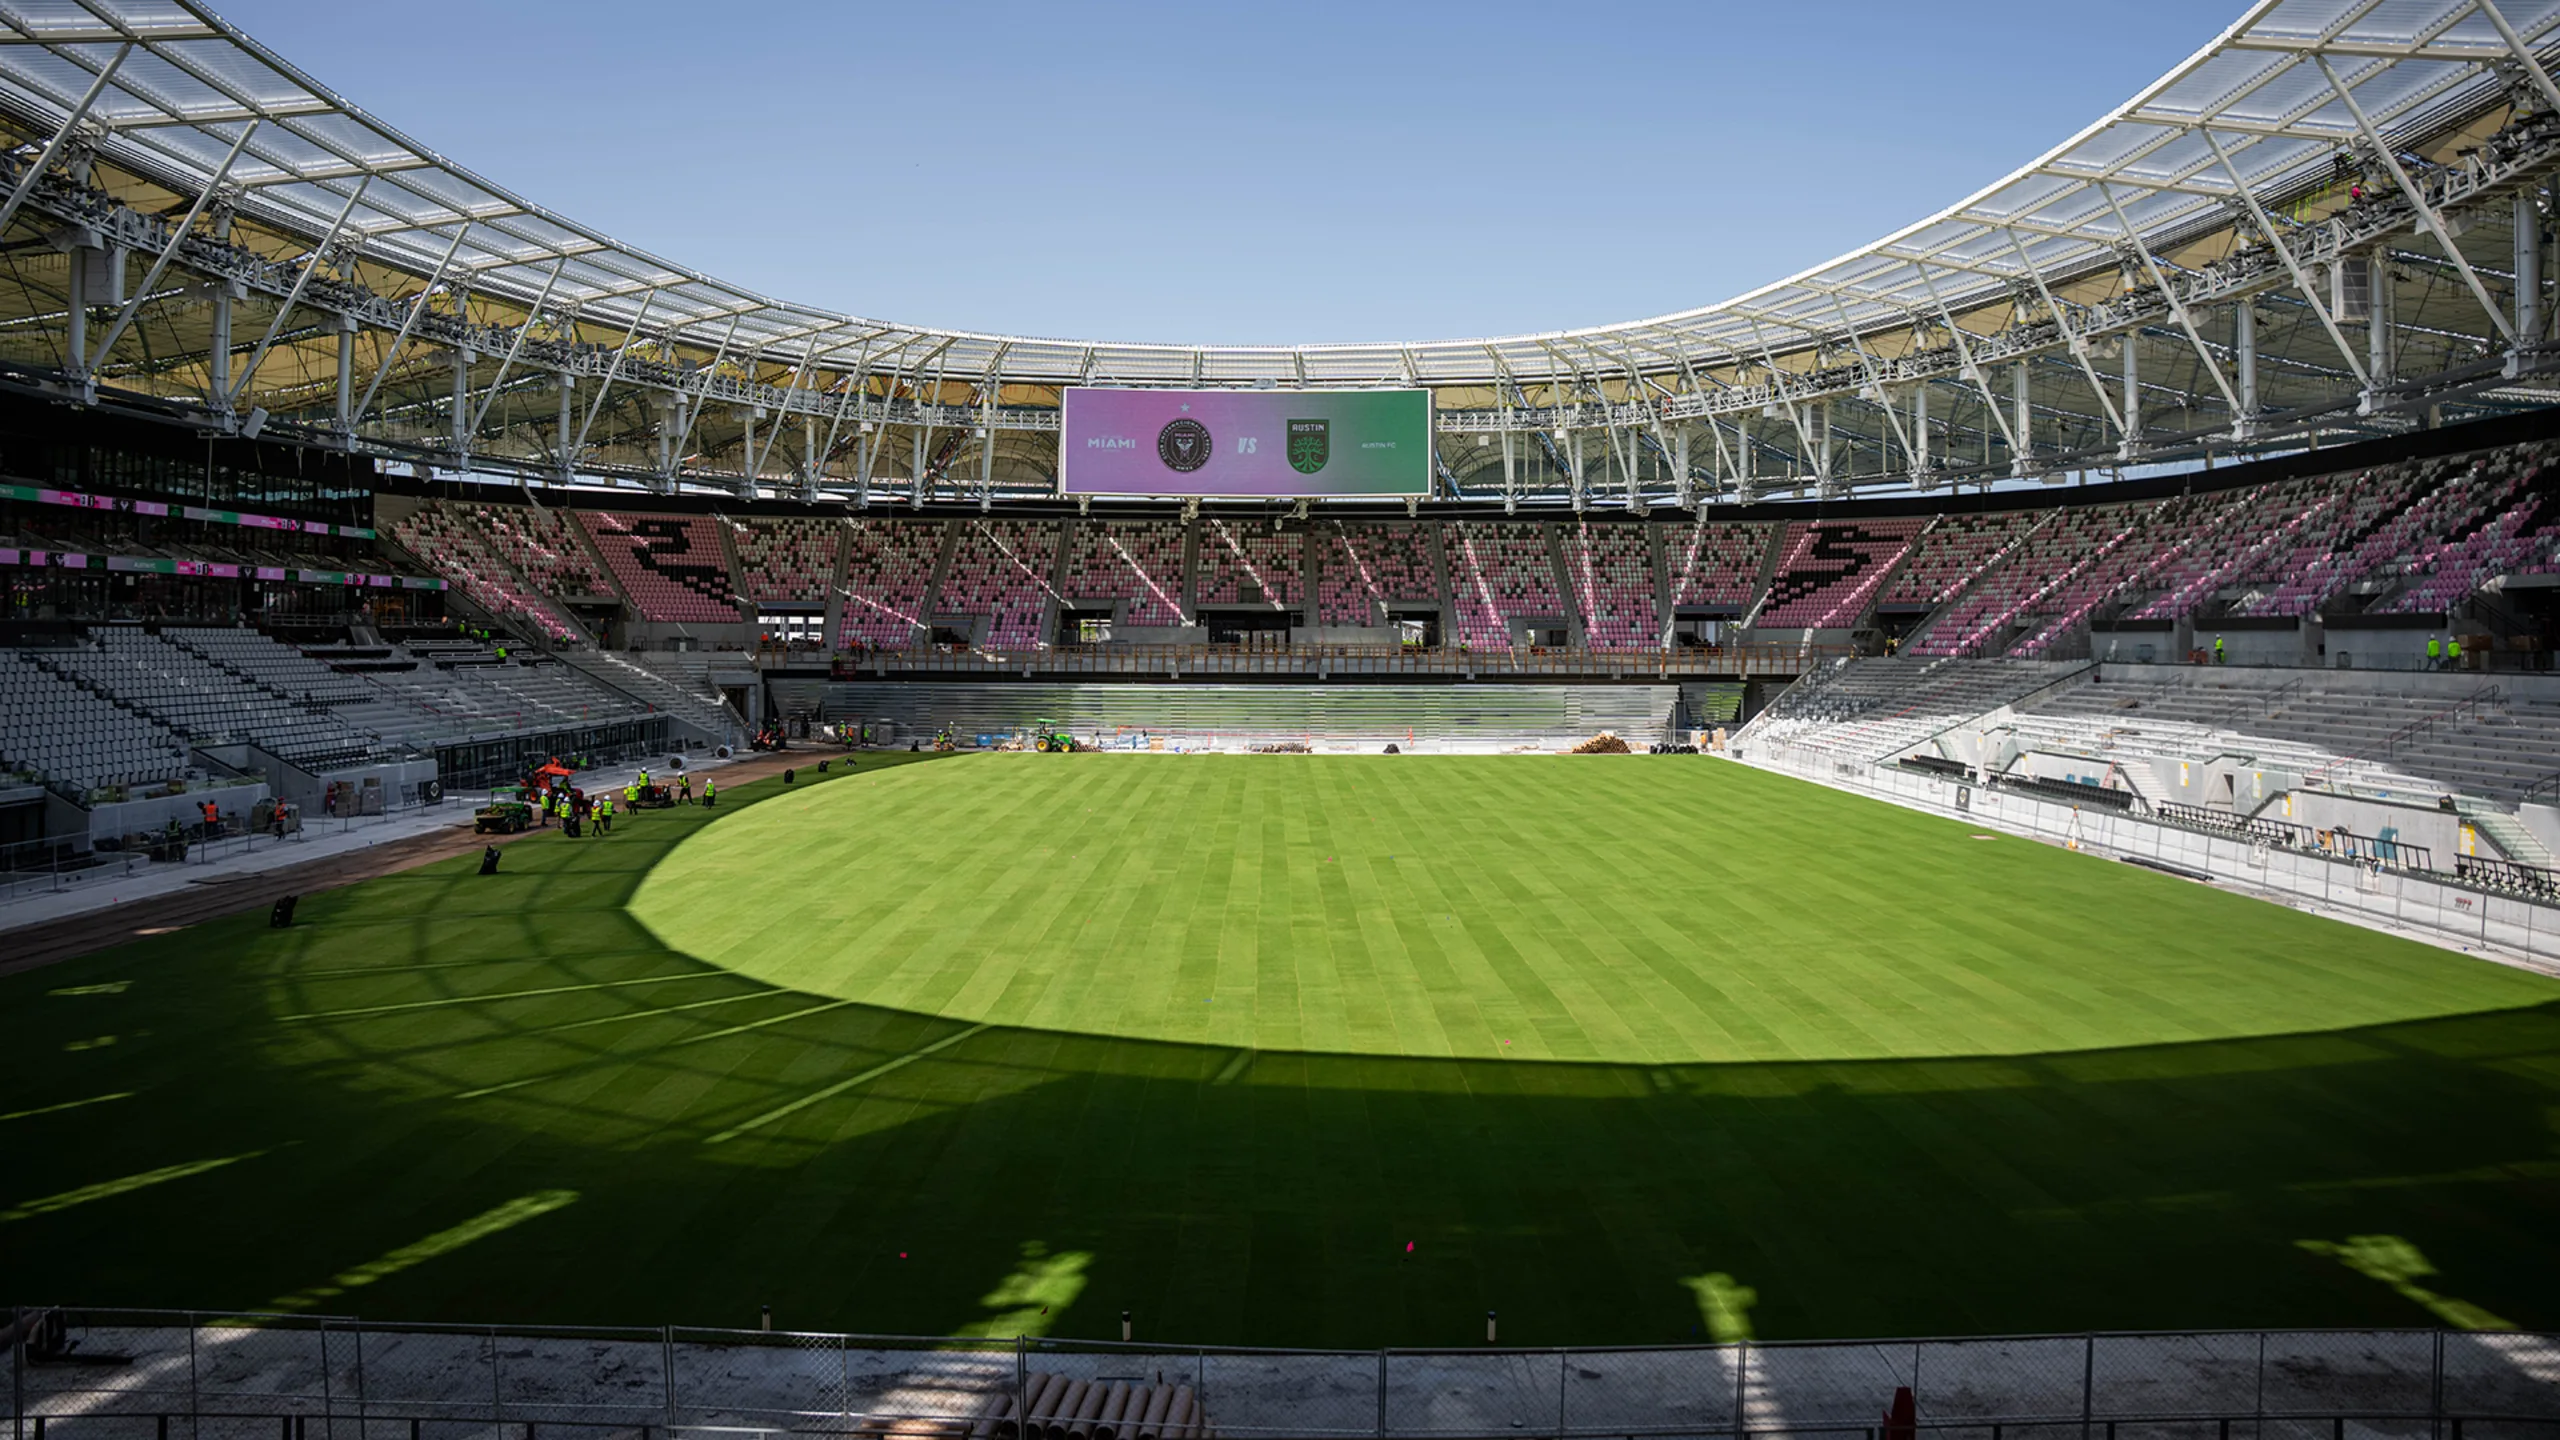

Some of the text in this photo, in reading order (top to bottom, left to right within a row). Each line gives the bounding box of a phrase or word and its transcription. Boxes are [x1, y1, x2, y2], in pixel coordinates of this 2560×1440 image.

[1291, 423, 1325, 431] AUSTIN
[1087, 438, 1136, 449] MIAMI
[1238, 437, 1257, 454] VS
